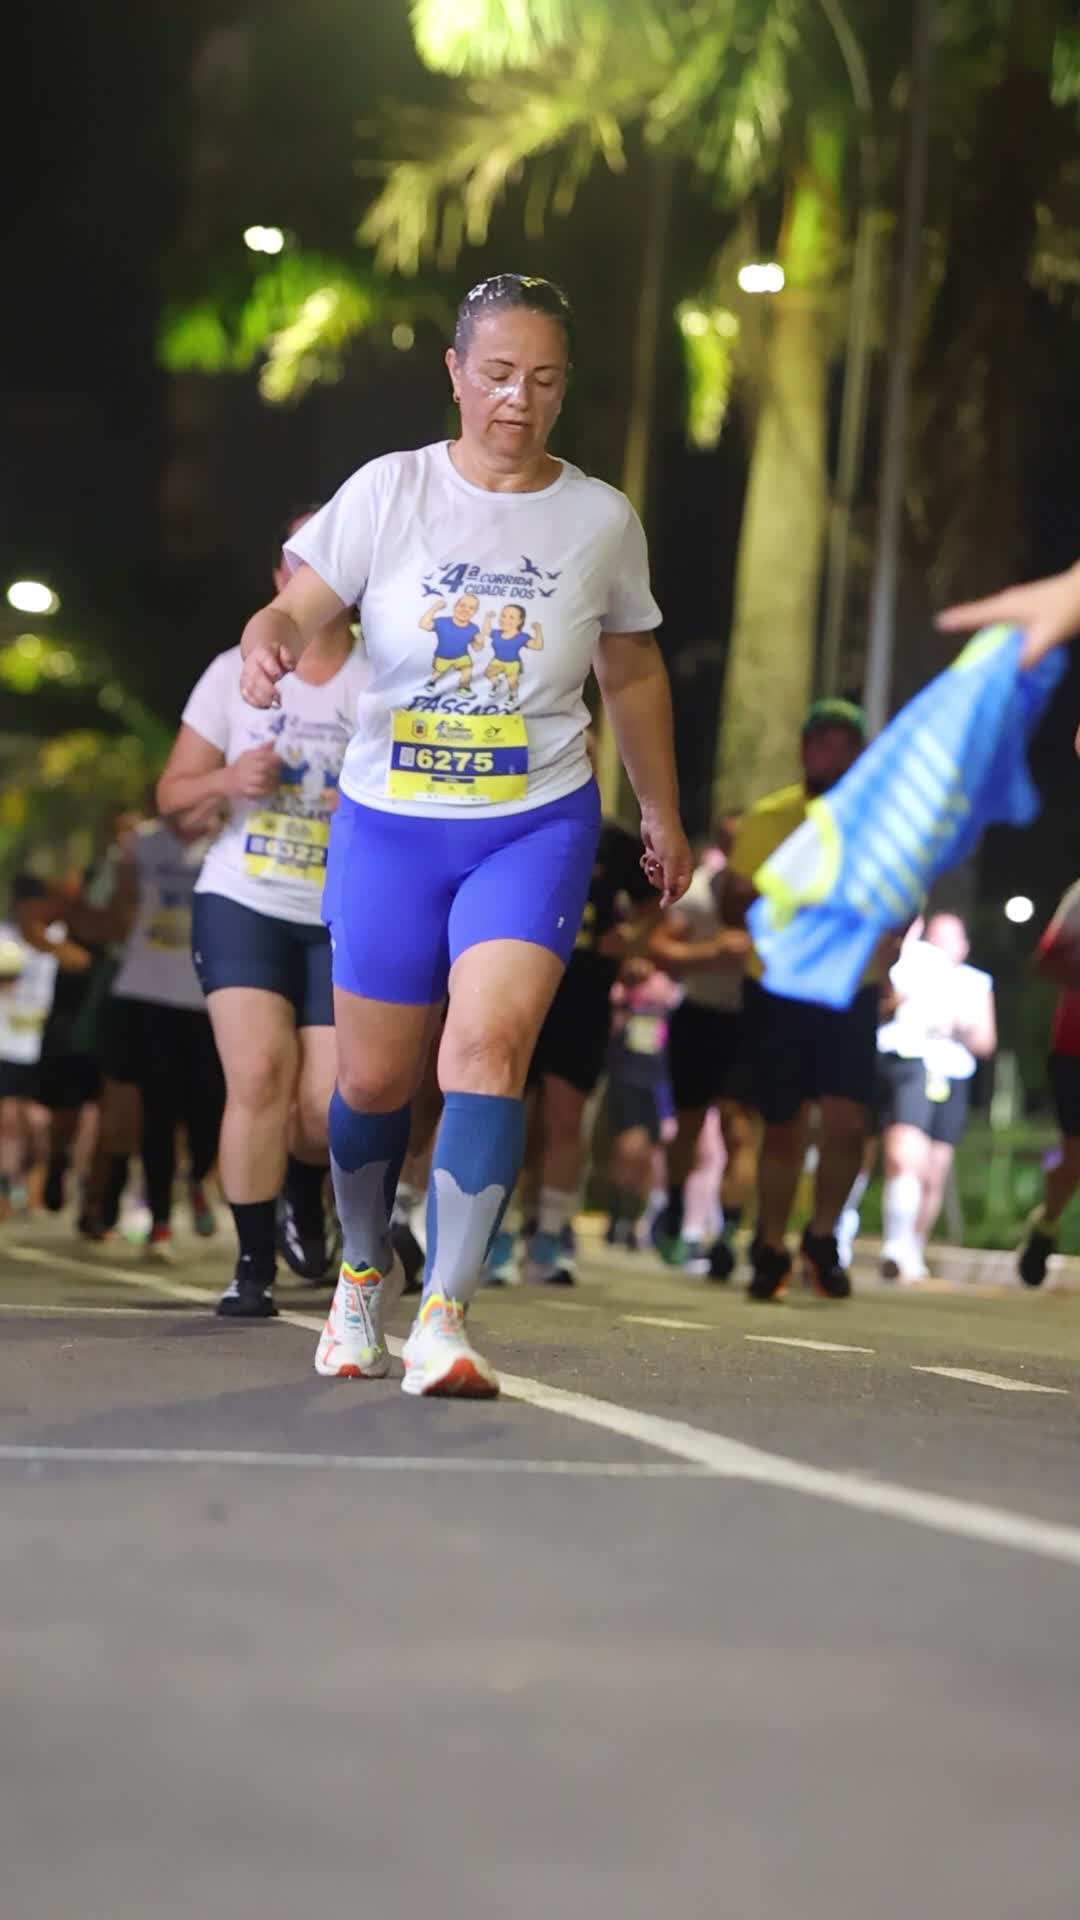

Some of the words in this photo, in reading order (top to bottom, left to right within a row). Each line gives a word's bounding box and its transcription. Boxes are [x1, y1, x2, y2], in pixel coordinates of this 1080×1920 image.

[480, 573, 533, 586] CORRIDA
[464, 584, 507, 597] CIDADE
[509, 586, 536, 600] DOS
[416, 748, 494, 772] 6275
[265, 838, 325, 866] 6322
